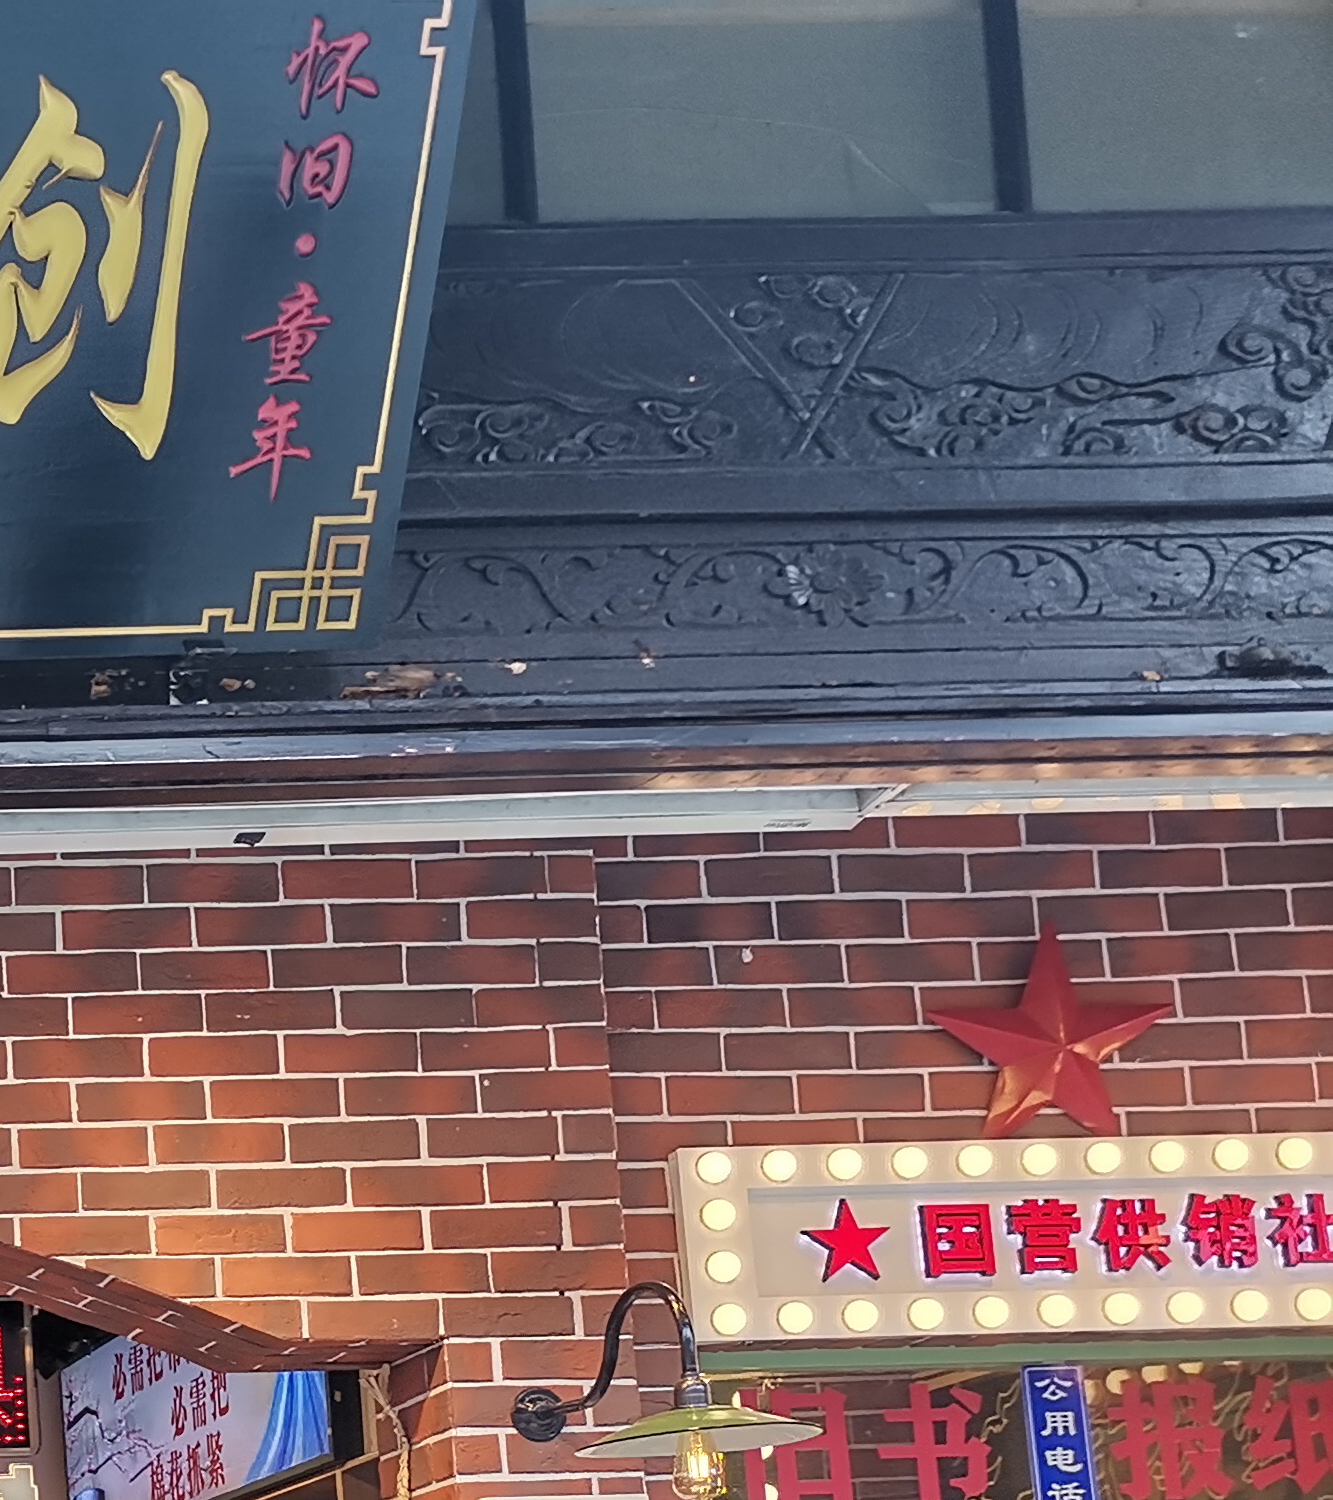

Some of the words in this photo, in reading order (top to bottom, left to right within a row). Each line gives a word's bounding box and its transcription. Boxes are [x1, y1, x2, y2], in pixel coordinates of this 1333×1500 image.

[229, 16, 379, 500] 怀旧·童年
[917, 1192, 1333, 1276] 国营供销社
